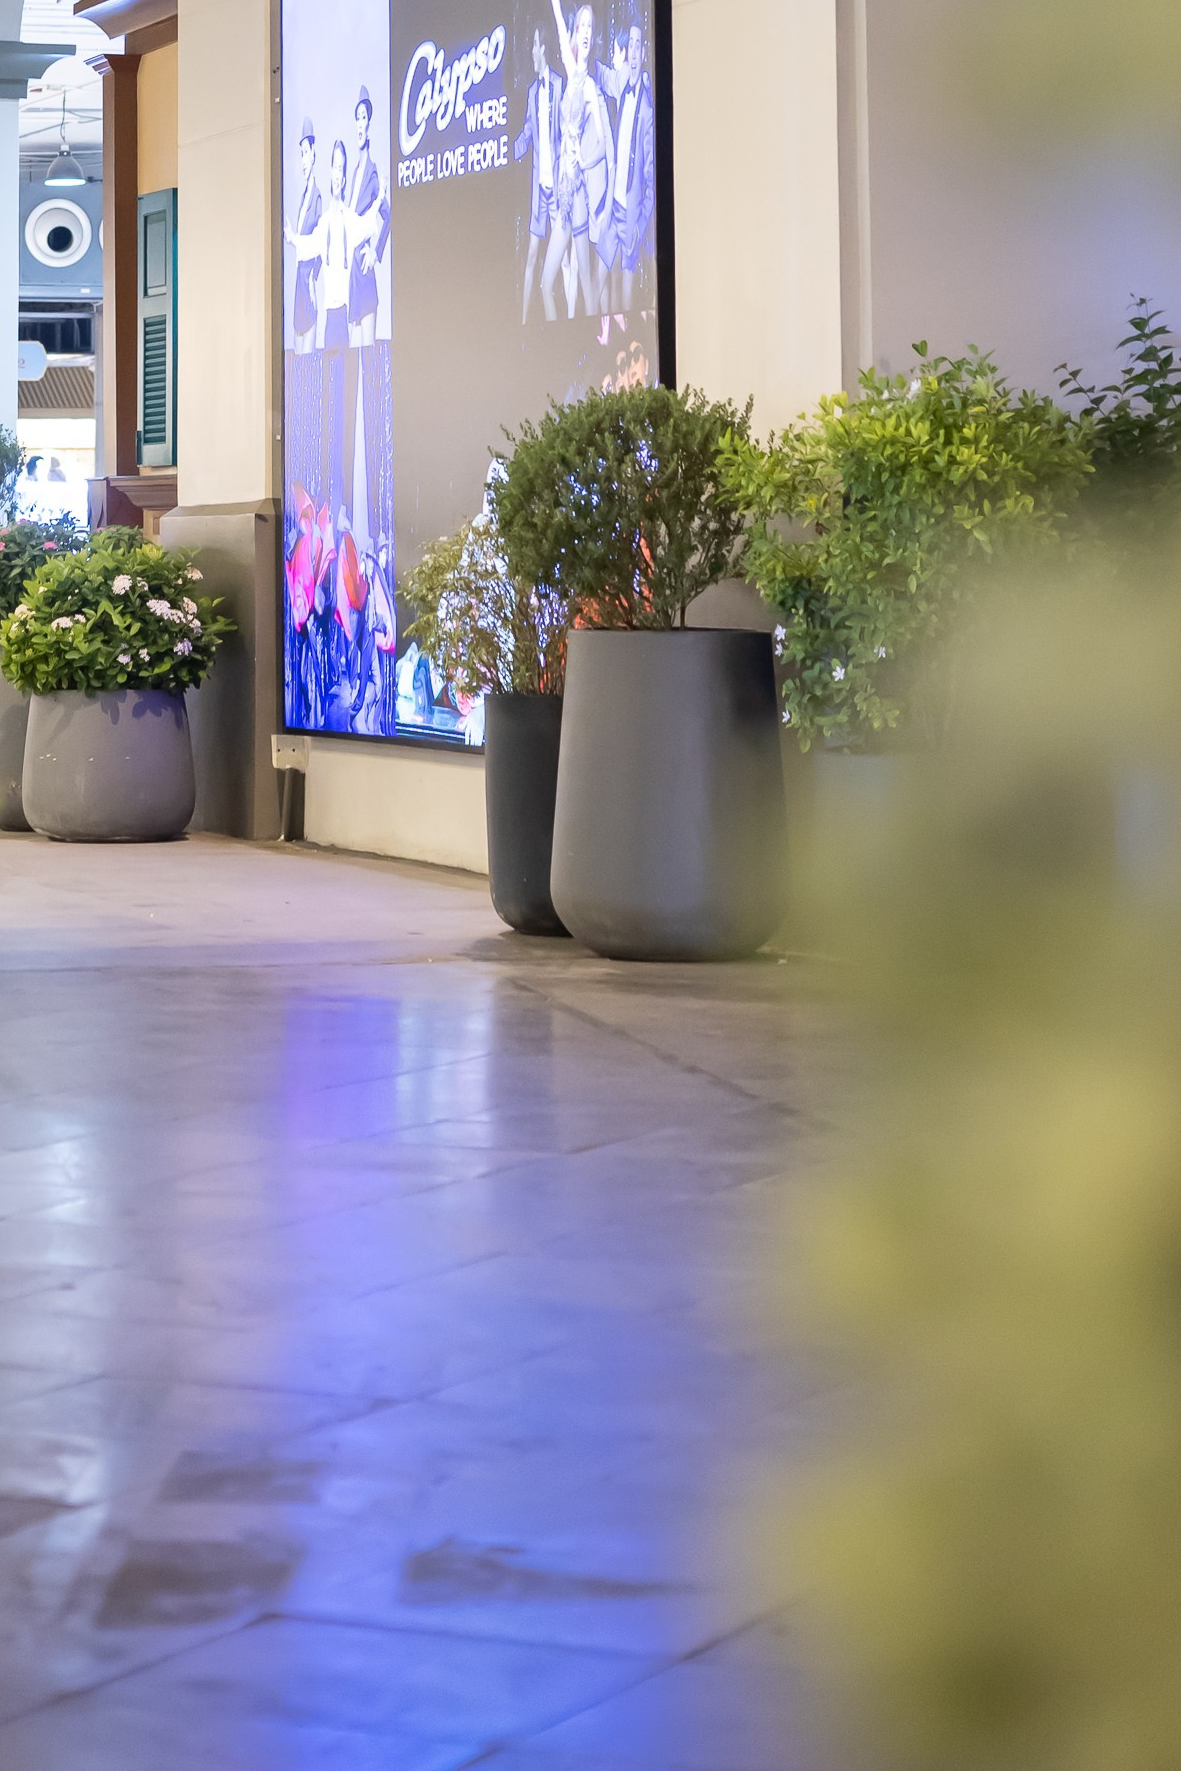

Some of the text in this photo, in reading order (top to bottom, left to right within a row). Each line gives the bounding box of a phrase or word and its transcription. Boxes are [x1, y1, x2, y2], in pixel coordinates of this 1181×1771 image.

[399, 25, 506, 156] Calypso
[465, 95, 508, 133] WHERE
[398, 135, 508, 187] PEOPLE LOVE PEOPLE
